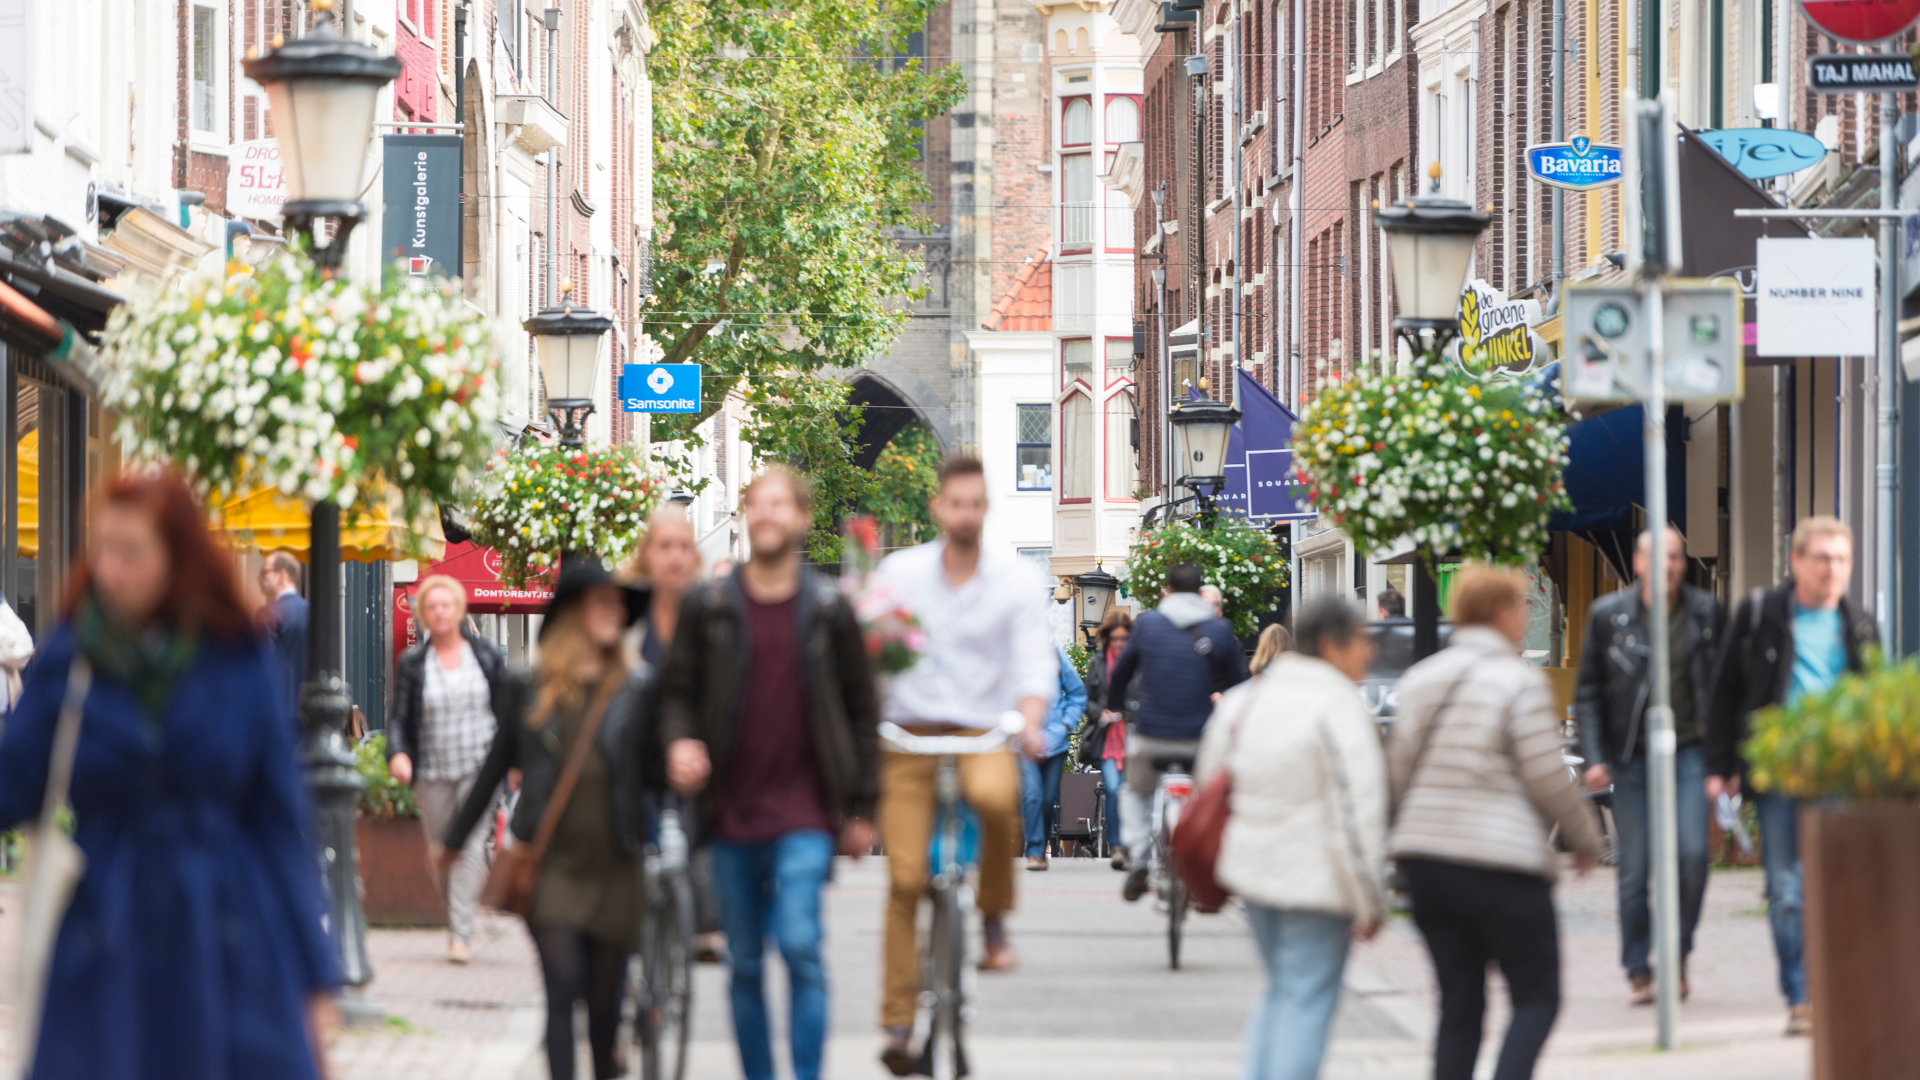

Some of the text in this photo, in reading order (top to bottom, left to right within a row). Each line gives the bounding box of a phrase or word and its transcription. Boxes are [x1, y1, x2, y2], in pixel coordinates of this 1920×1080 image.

[1815, 62, 1917, 83] TAJ MAHAL
[1540, 154, 1622, 174] Bavaria
[412, 151, 429, 247] Kunstgalerie
[1480, 291, 1494, 310] de
[1769, 288, 1863, 298] NUMBER NINE
[1481, 303, 1526, 336] groene
[627, 397, 695, 409] Samsonite
